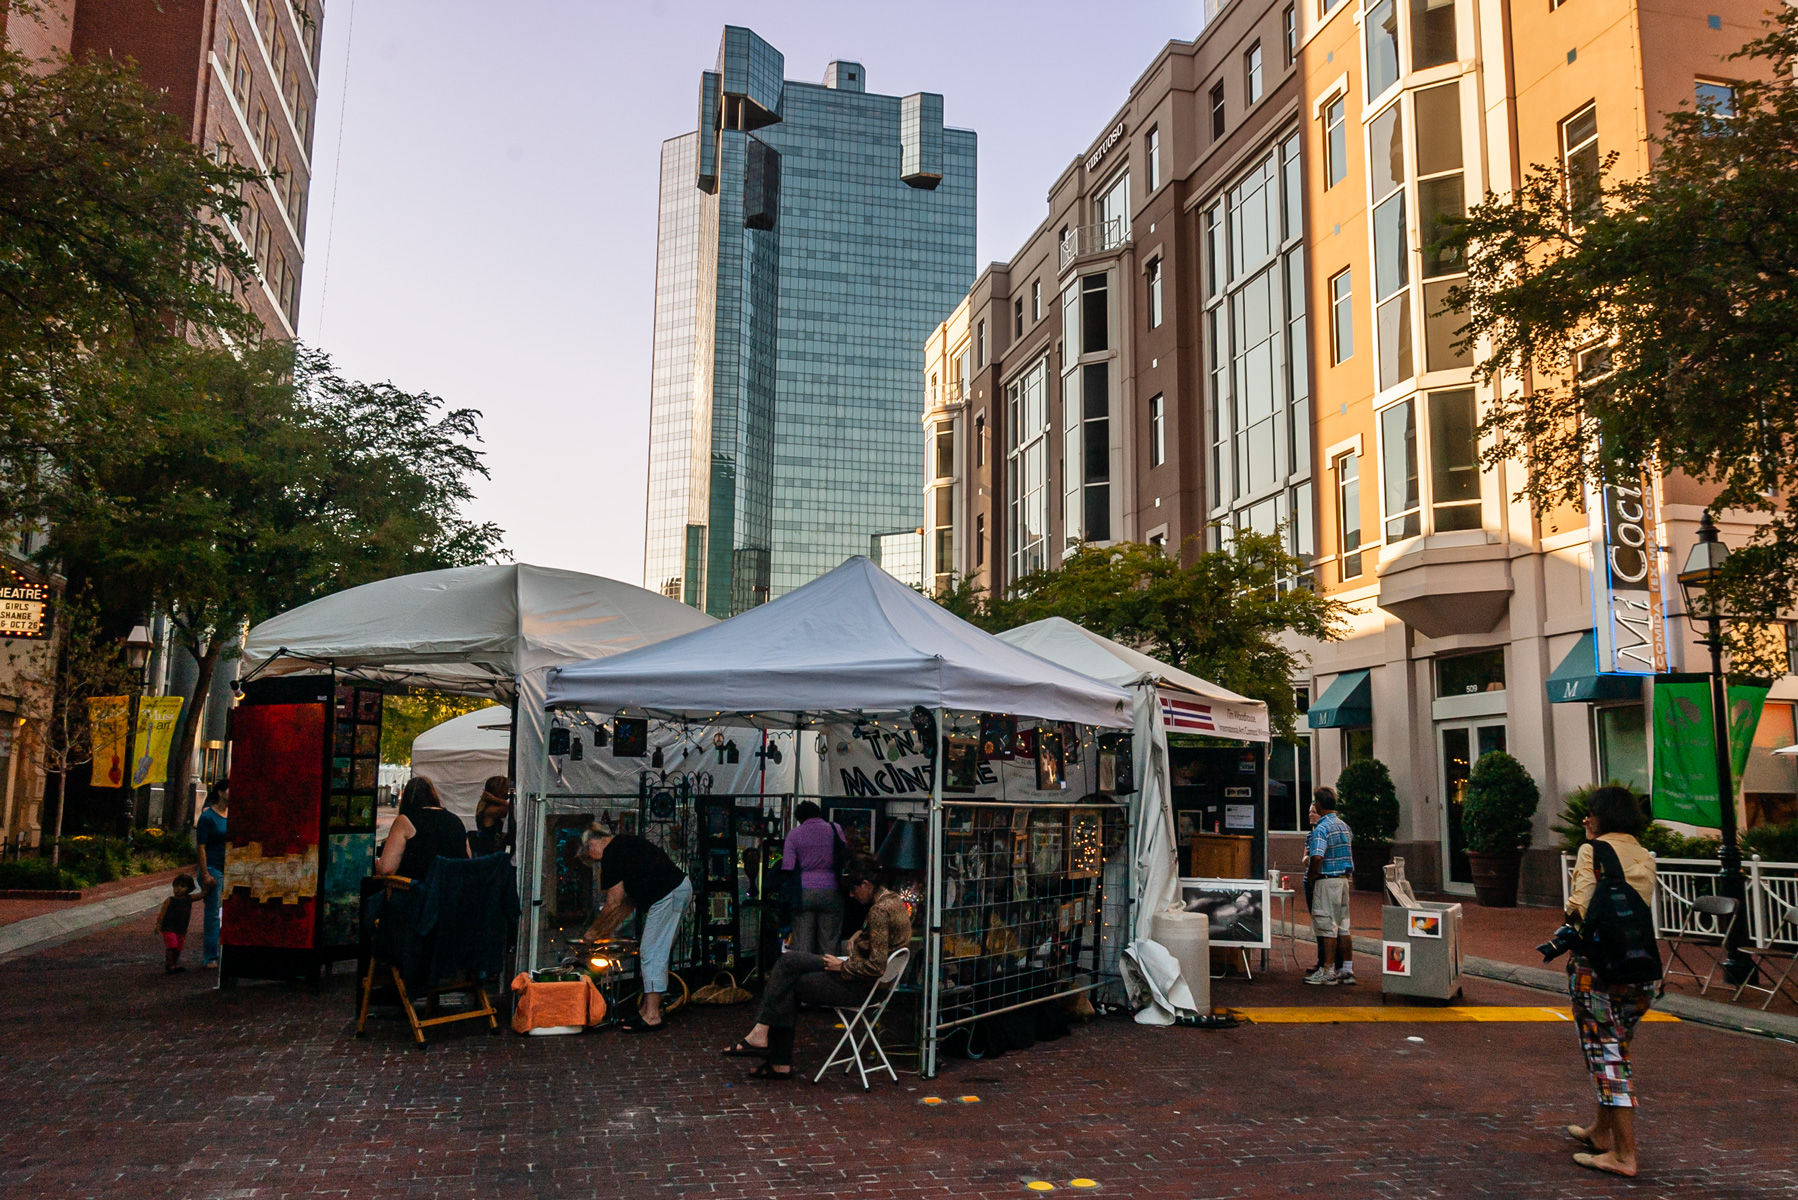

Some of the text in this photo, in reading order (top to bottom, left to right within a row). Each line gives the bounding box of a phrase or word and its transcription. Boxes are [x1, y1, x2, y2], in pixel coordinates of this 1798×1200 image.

[1085, 122, 1123, 173] VIRTUOSO
[1646, 529, 1660, 592] TEX-MEX
[1604, 478, 1656, 669] Mi Coci
[0, 611, 32, 620] SHANGE
[5, 602, 30, 611] GIRLS
[10, 621, 26, 629] OCT
[1652, 602, 1665, 668] COMIDA
[1466, 684, 1478, 693] 509
[1563, 681, 1579, 699] M
